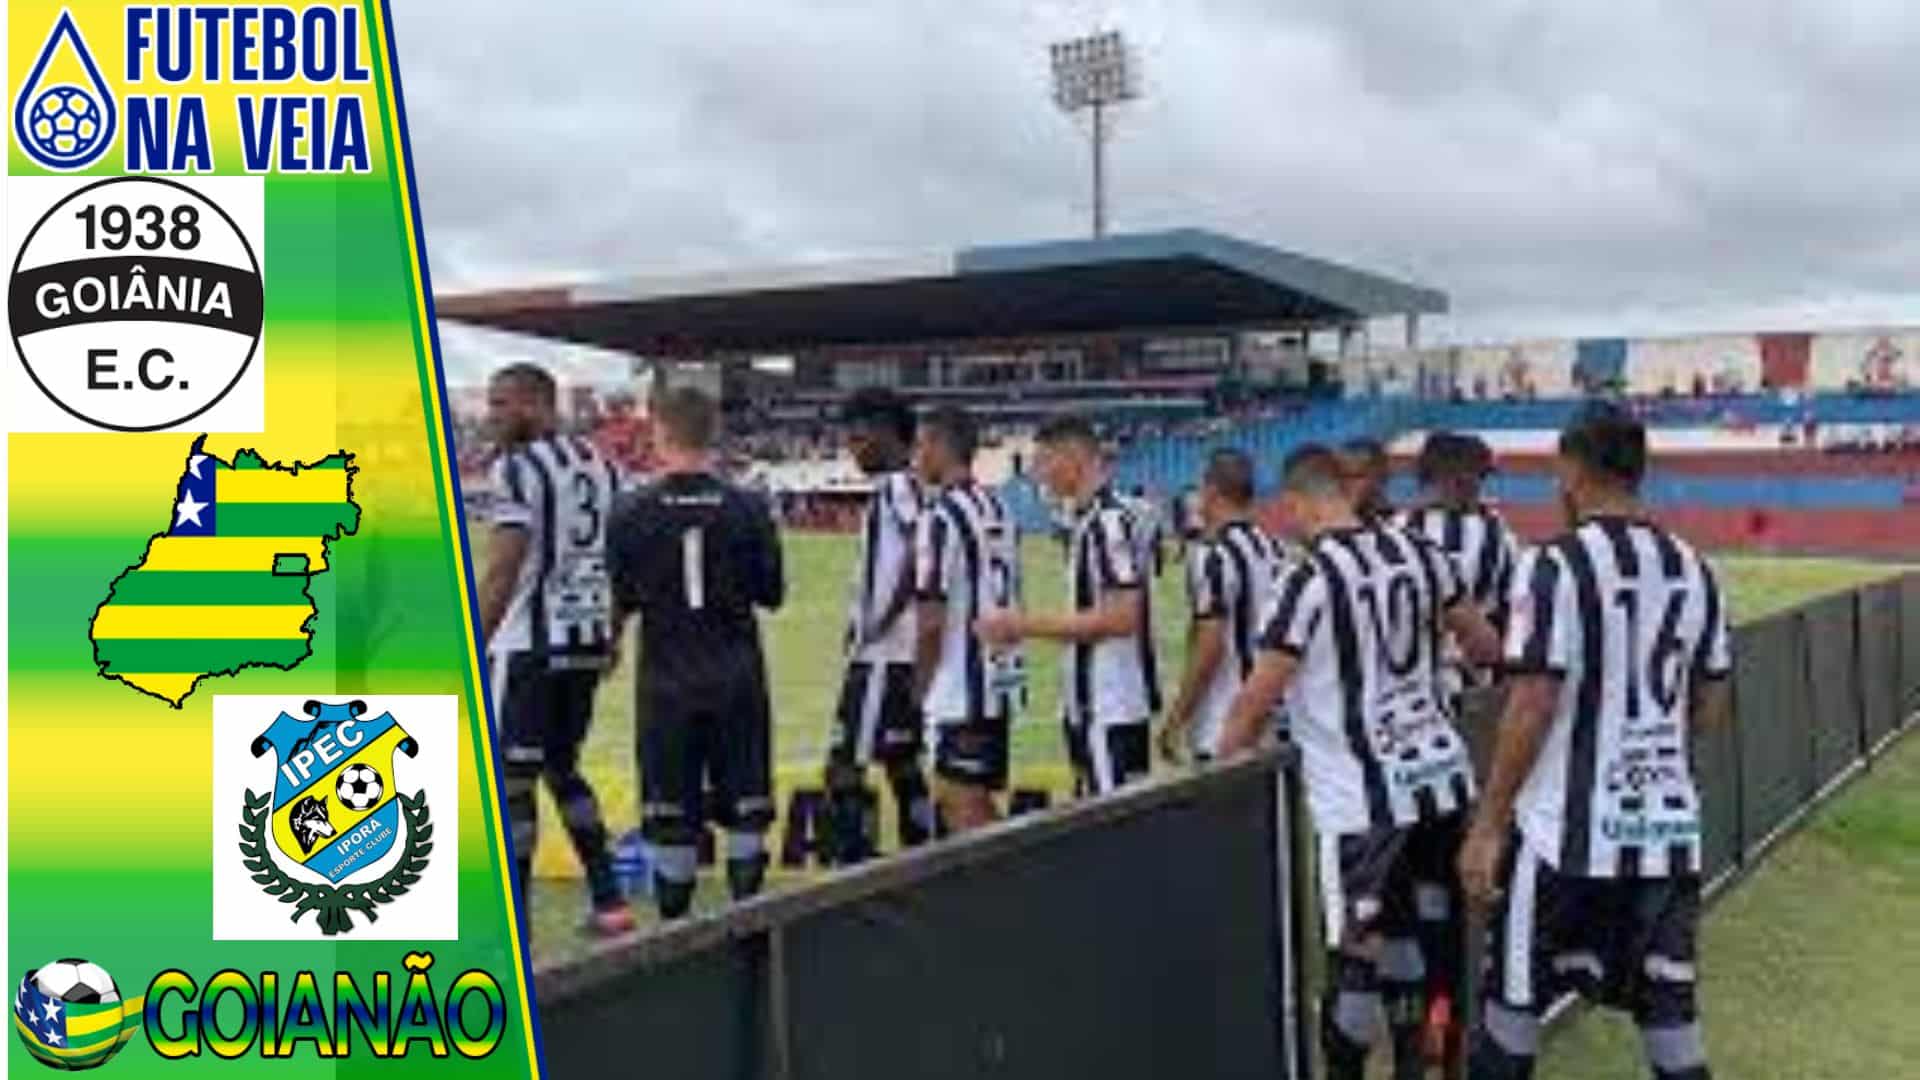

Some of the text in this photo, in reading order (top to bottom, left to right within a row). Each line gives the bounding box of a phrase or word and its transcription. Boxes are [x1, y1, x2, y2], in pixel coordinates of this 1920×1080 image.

[572, 473, 598, 547] 3
[682, 526, 704, 609] 1
[1357, 572, 1420, 675] 10
[1613, 588, 1688, 718] 16
